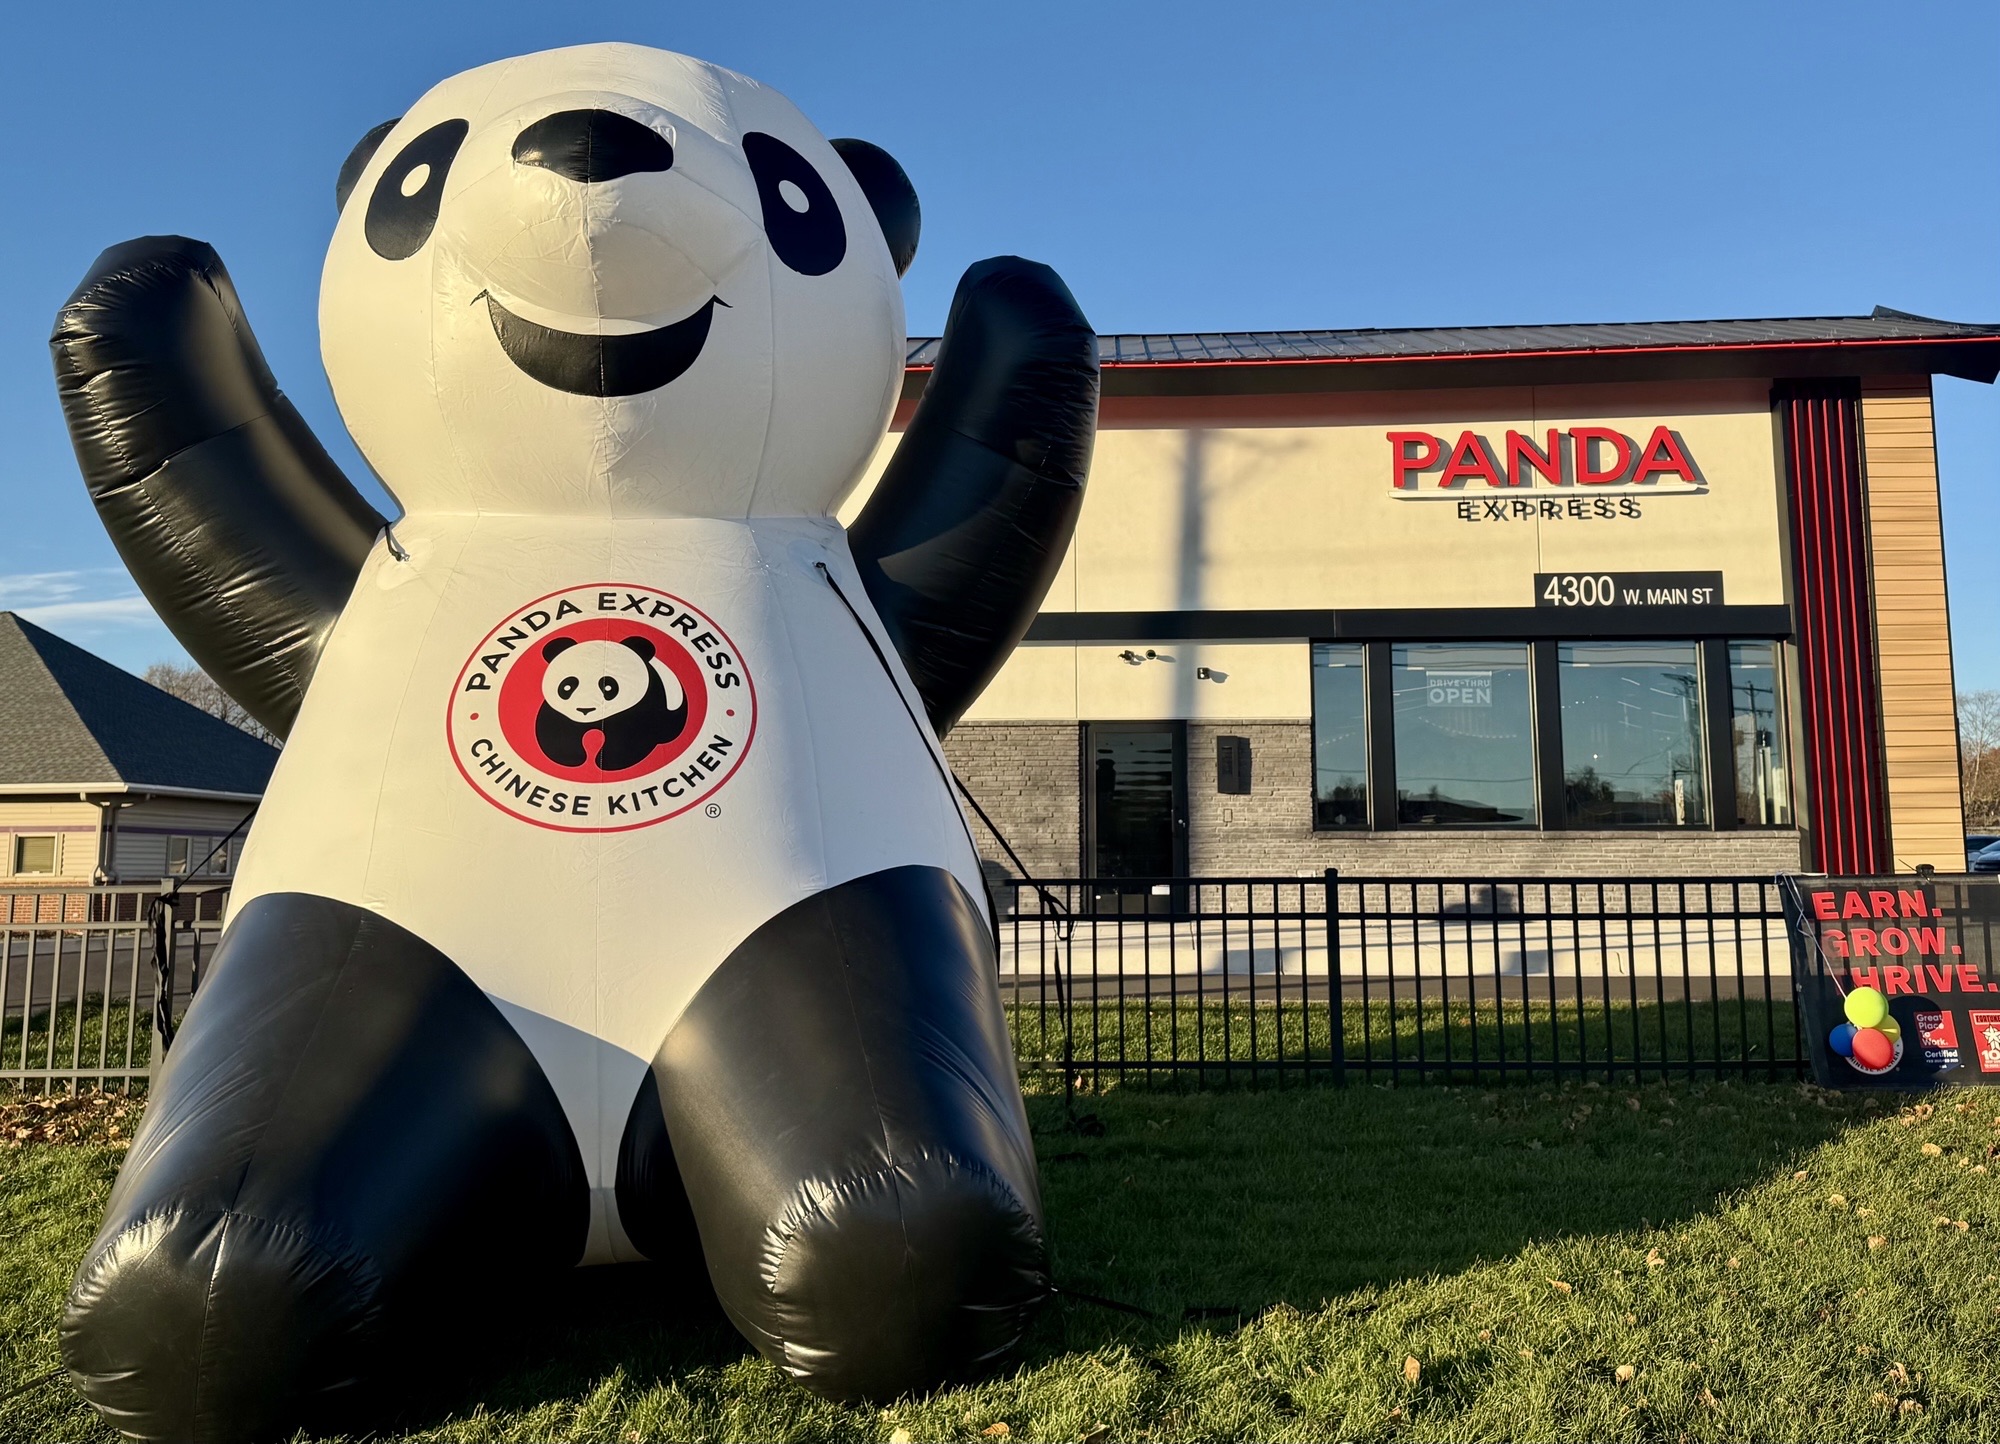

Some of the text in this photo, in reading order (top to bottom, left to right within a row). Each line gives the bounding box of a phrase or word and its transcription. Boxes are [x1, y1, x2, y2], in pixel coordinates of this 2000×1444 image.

[1387, 425, 1696, 488] PANDA
[1457, 498, 1634, 520] EXPRESS
[1543, 575, 1713, 606] 4300 W. MAIN ST
[465, 592, 740, 692] PANDA EXPRESS
[1430, 679, 1490, 687] DRIVE-THRU
[1430, 688, 1491, 704] OPEN
[470, 734, 734, 816] CHINESE KITCHEN
[1811, 889, 1943, 920] EARN.
[1820, 926, 1963, 958] GROW.
[1916, 1013, 1943, 1022] Great
[1918, 1022, 1945, 1030] Place
[1925, 1050, 1958, 1058] Certified
